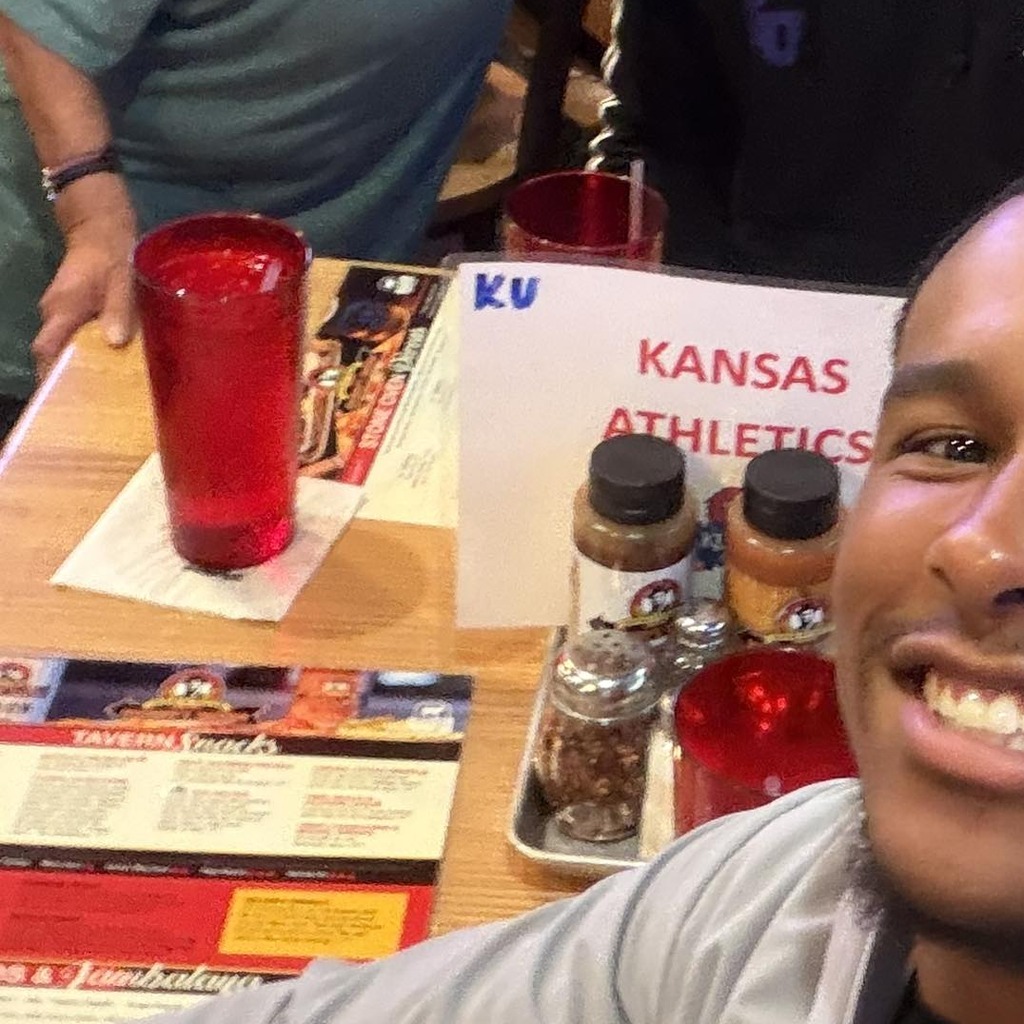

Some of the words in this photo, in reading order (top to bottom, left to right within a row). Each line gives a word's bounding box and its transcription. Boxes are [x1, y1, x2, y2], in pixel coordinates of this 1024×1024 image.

[473, 272, 540, 310] KU
[638, 338, 850, 395] KANSAS
[603, 407, 874, 464] ATHLETICS
[72, 730, 180, 751] TAVERN
